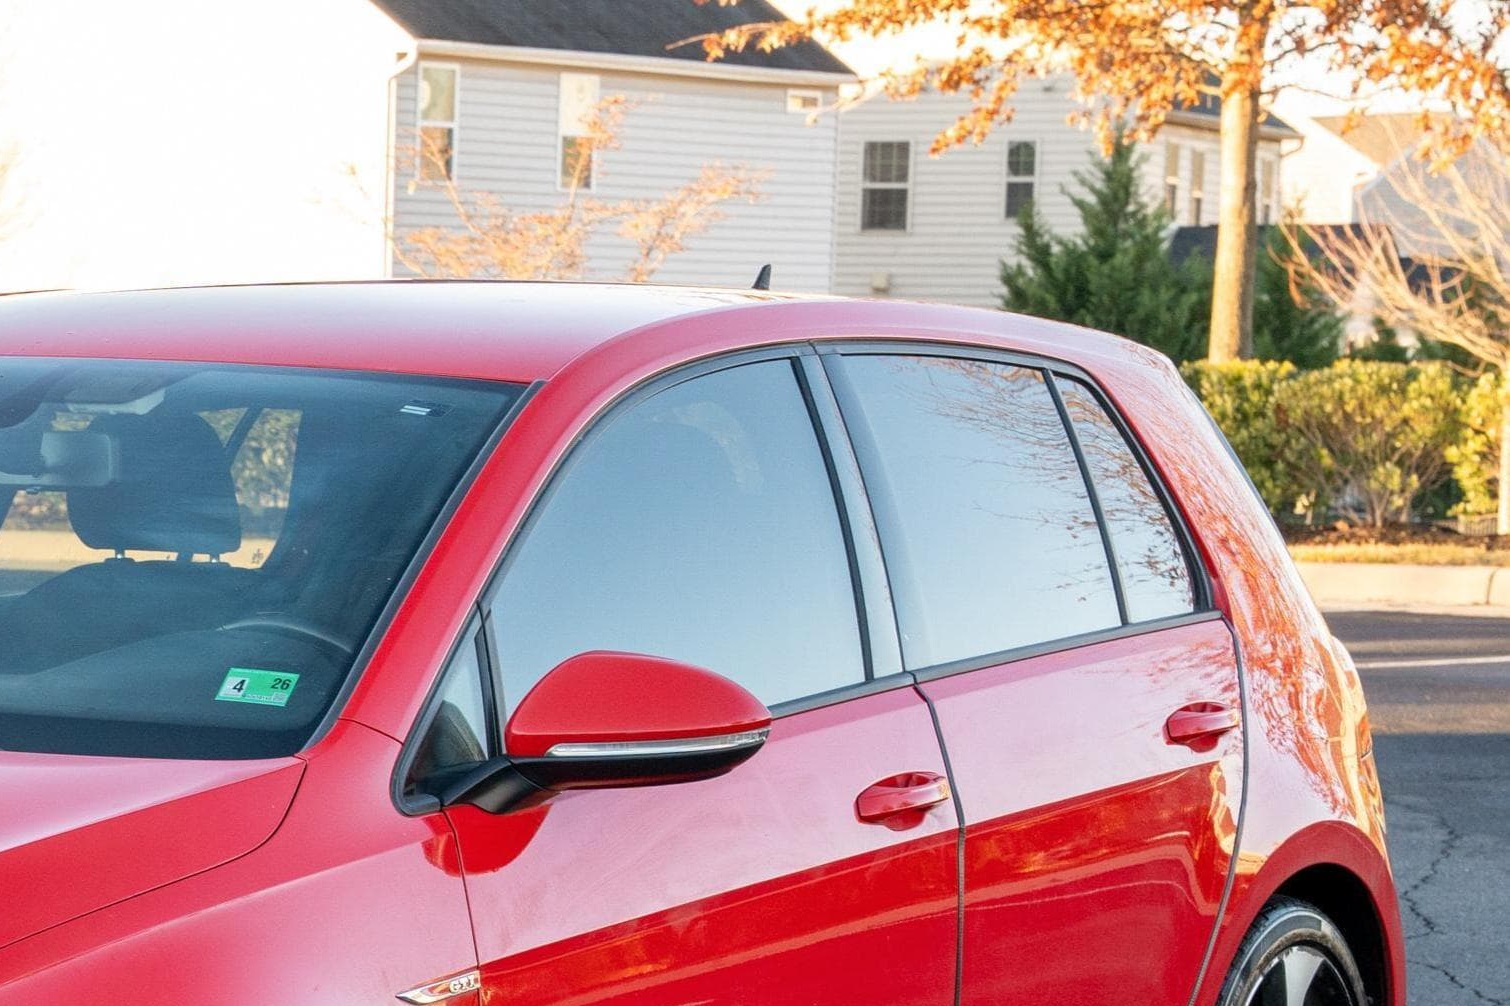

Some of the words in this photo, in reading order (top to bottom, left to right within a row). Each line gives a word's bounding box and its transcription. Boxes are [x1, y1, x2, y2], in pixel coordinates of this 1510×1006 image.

[232, 679, 247, 693] 4
[271, 678, 292, 690] 26
[449, 974, 475, 994] GTI
